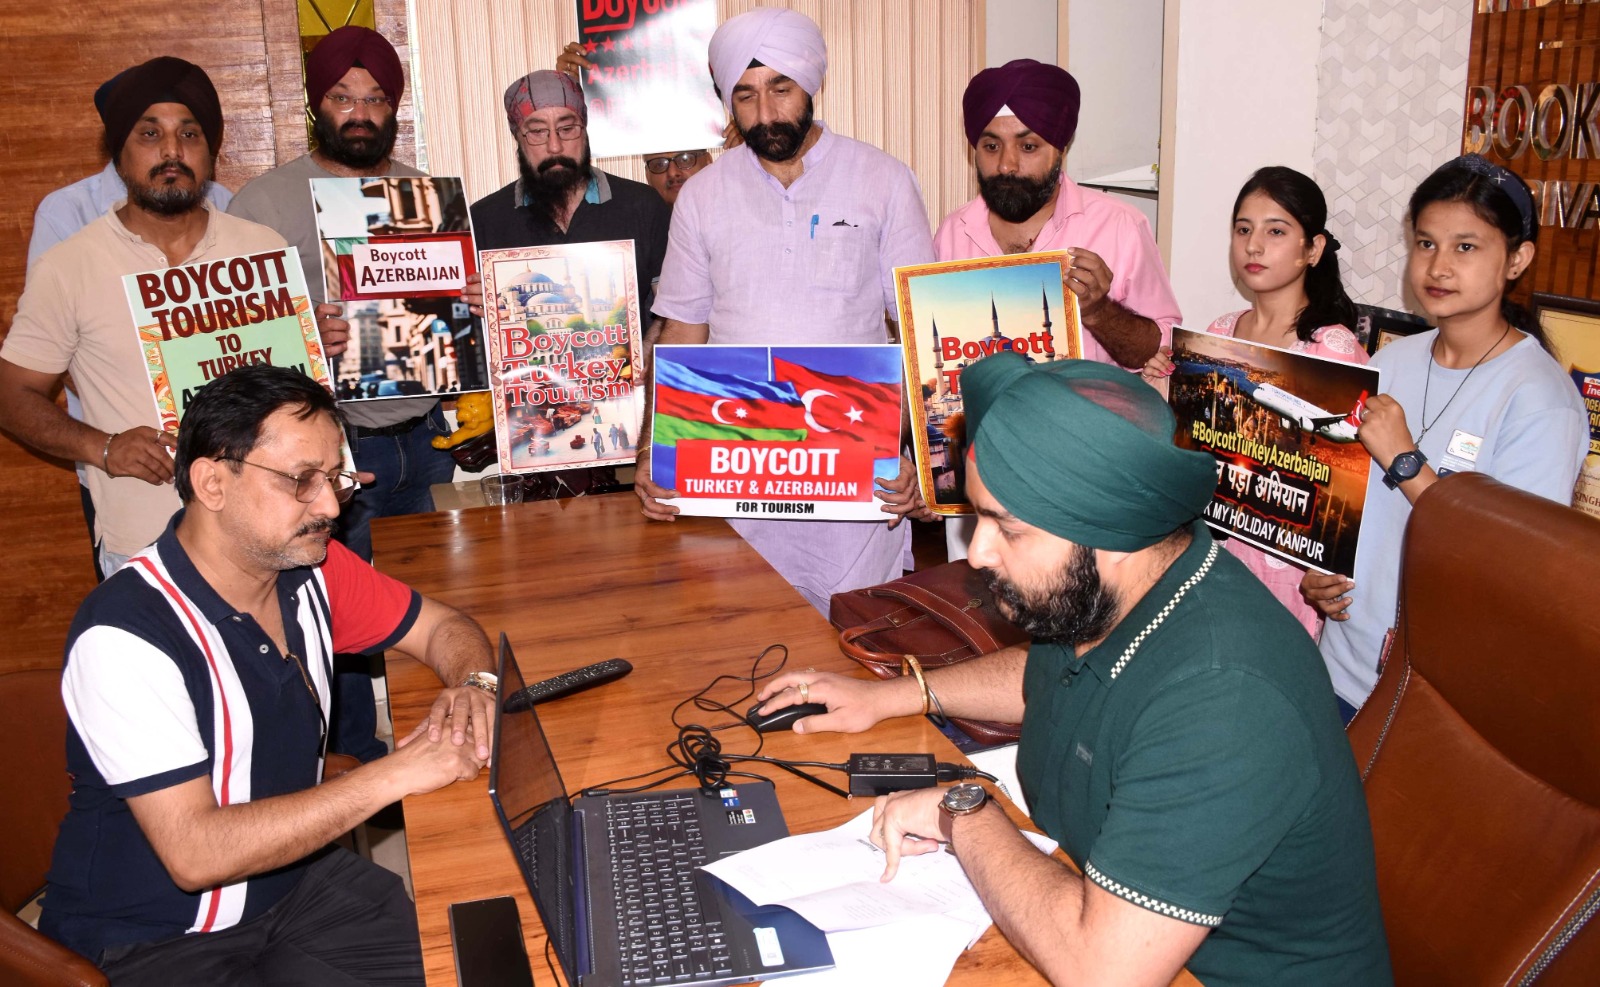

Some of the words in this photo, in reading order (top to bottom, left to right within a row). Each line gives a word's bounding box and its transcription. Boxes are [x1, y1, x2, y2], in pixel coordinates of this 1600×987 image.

[1464, 83, 1600, 160] BOOK
[1524, 178, 1600, 229] IVA
[370, 248, 427, 264] Boycott
[136, 250, 288, 309] BOYCOTT
[360, 265, 460, 287] AZERBAIJAN
[152, 287, 299, 341] TOURISM
[215, 333, 242, 354] TO
[501, 324, 629, 360] Boycott
[941, 331, 1055, 361] Boycott
[502, 352, 627, 385] Turkey
[506, 380, 632, 407] Tourism
[710, 447, 840, 476] BOYCOTT
[1192, 420, 1330, 484] #BoycottTurkeyAzerbaijan
[685, 479, 744, 494] TURKEY
[748, 480, 759, 494] &
[764, 480, 857, 496] AZERBAIJAN
[1254, 470, 1309, 514] अभियान
[736, 502, 758, 513] FOR
[761, 502, 815, 514] TOURISM
[1212, 502, 1229, 522] MY
[1229, 508, 1276, 543] HOLIDAY
[1275, 524, 1324, 562] KANPUR
